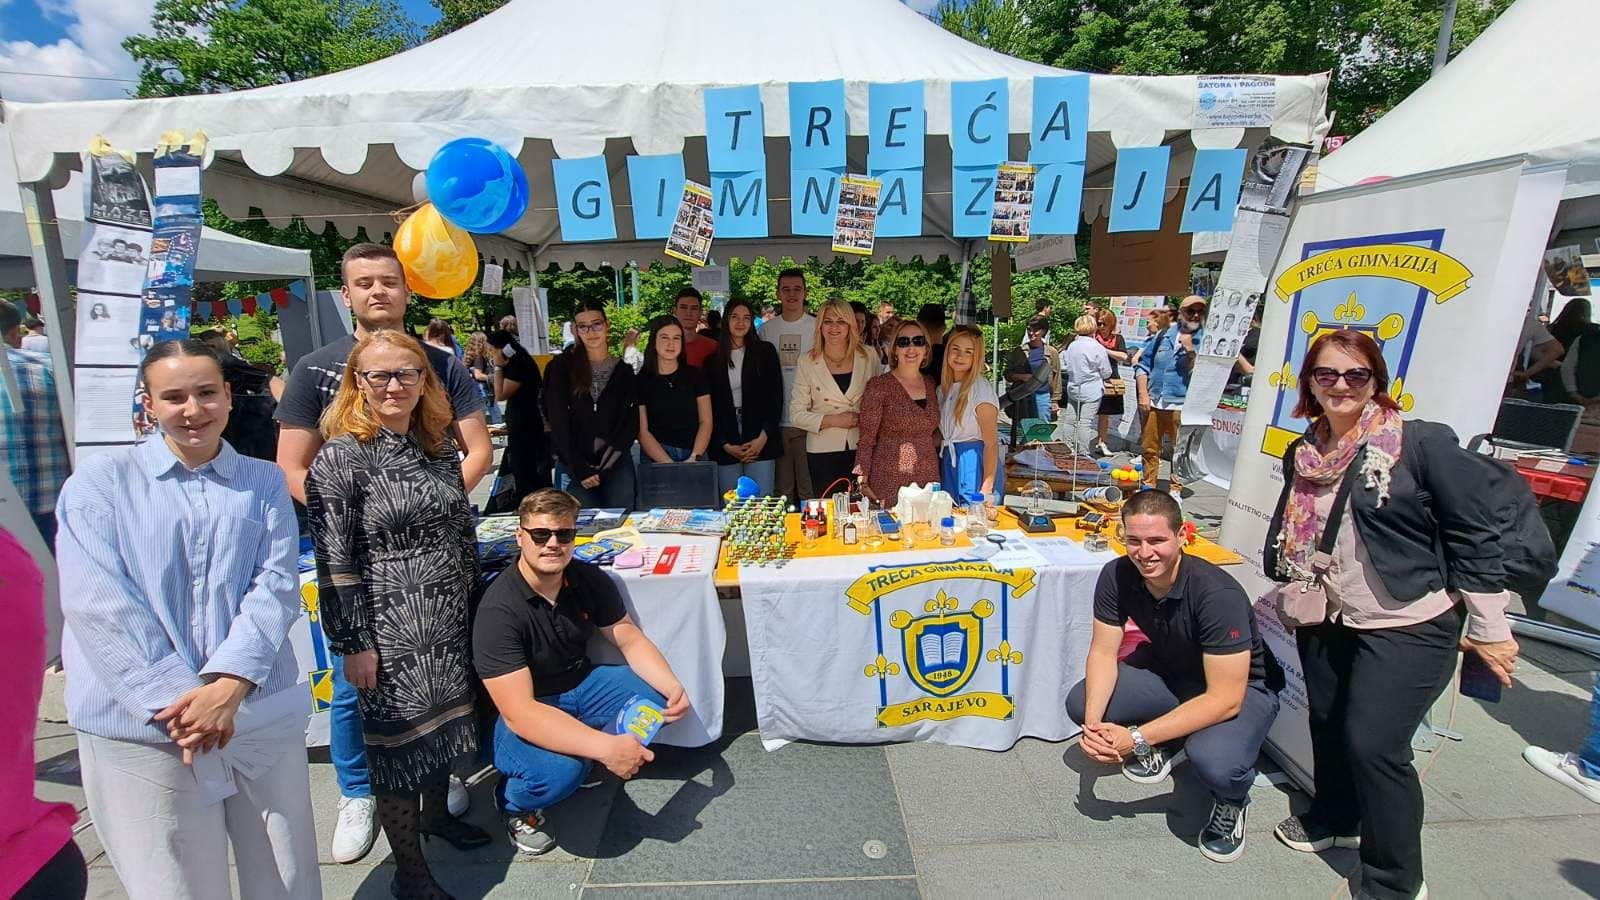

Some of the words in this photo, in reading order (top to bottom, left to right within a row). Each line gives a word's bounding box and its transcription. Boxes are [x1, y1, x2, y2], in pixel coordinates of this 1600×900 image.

[724, 91, 1071, 150] TREĆA
[571, 171, 1222, 219] GIMNAZIJA
[1297, 256, 1343, 282] TREĆA
[1347, 254, 1438, 275] GIMNAZIJA
[902, 697, 987, 717] SARAJEVO
